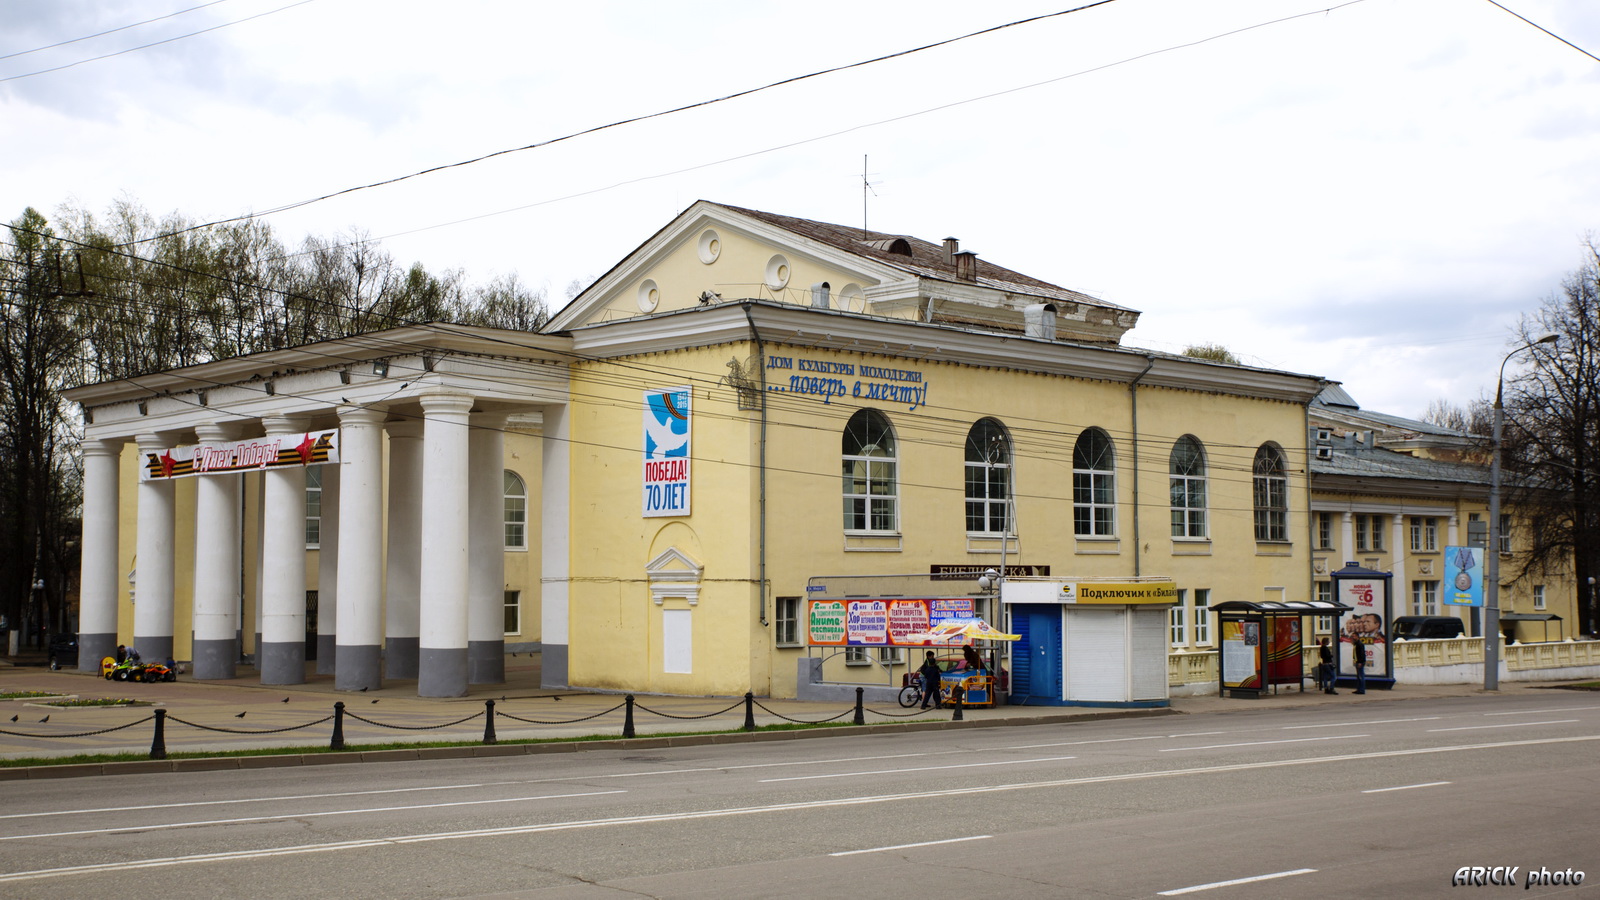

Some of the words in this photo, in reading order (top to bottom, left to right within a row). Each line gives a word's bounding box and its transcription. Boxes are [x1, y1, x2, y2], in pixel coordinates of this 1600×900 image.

[767, 356, 793, 369] ДОМ
[799, 359, 855, 375] КУЛЬТУРЫ
[860, 365, 922, 382] МОЛОДЕЖИ
[853, 381, 861, 397] в
[866, 382, 928, 411] мечту!
[192, 448, 202, 469] С
[200, 447, 233, 472] Днем
[236, 439, 280, 469] Победы!
[645, 460, 687, 482] ПОБЕДА!
[646, 485, 661, 511] 70
[662, 483, 687, 510] ЛЕТ
[931, 600, 936, 609] 8
[1081, 588, 1144, 599] Подключим
[1364, 589, 1373, 602] 6
[852, 603, 858, 611] 4
